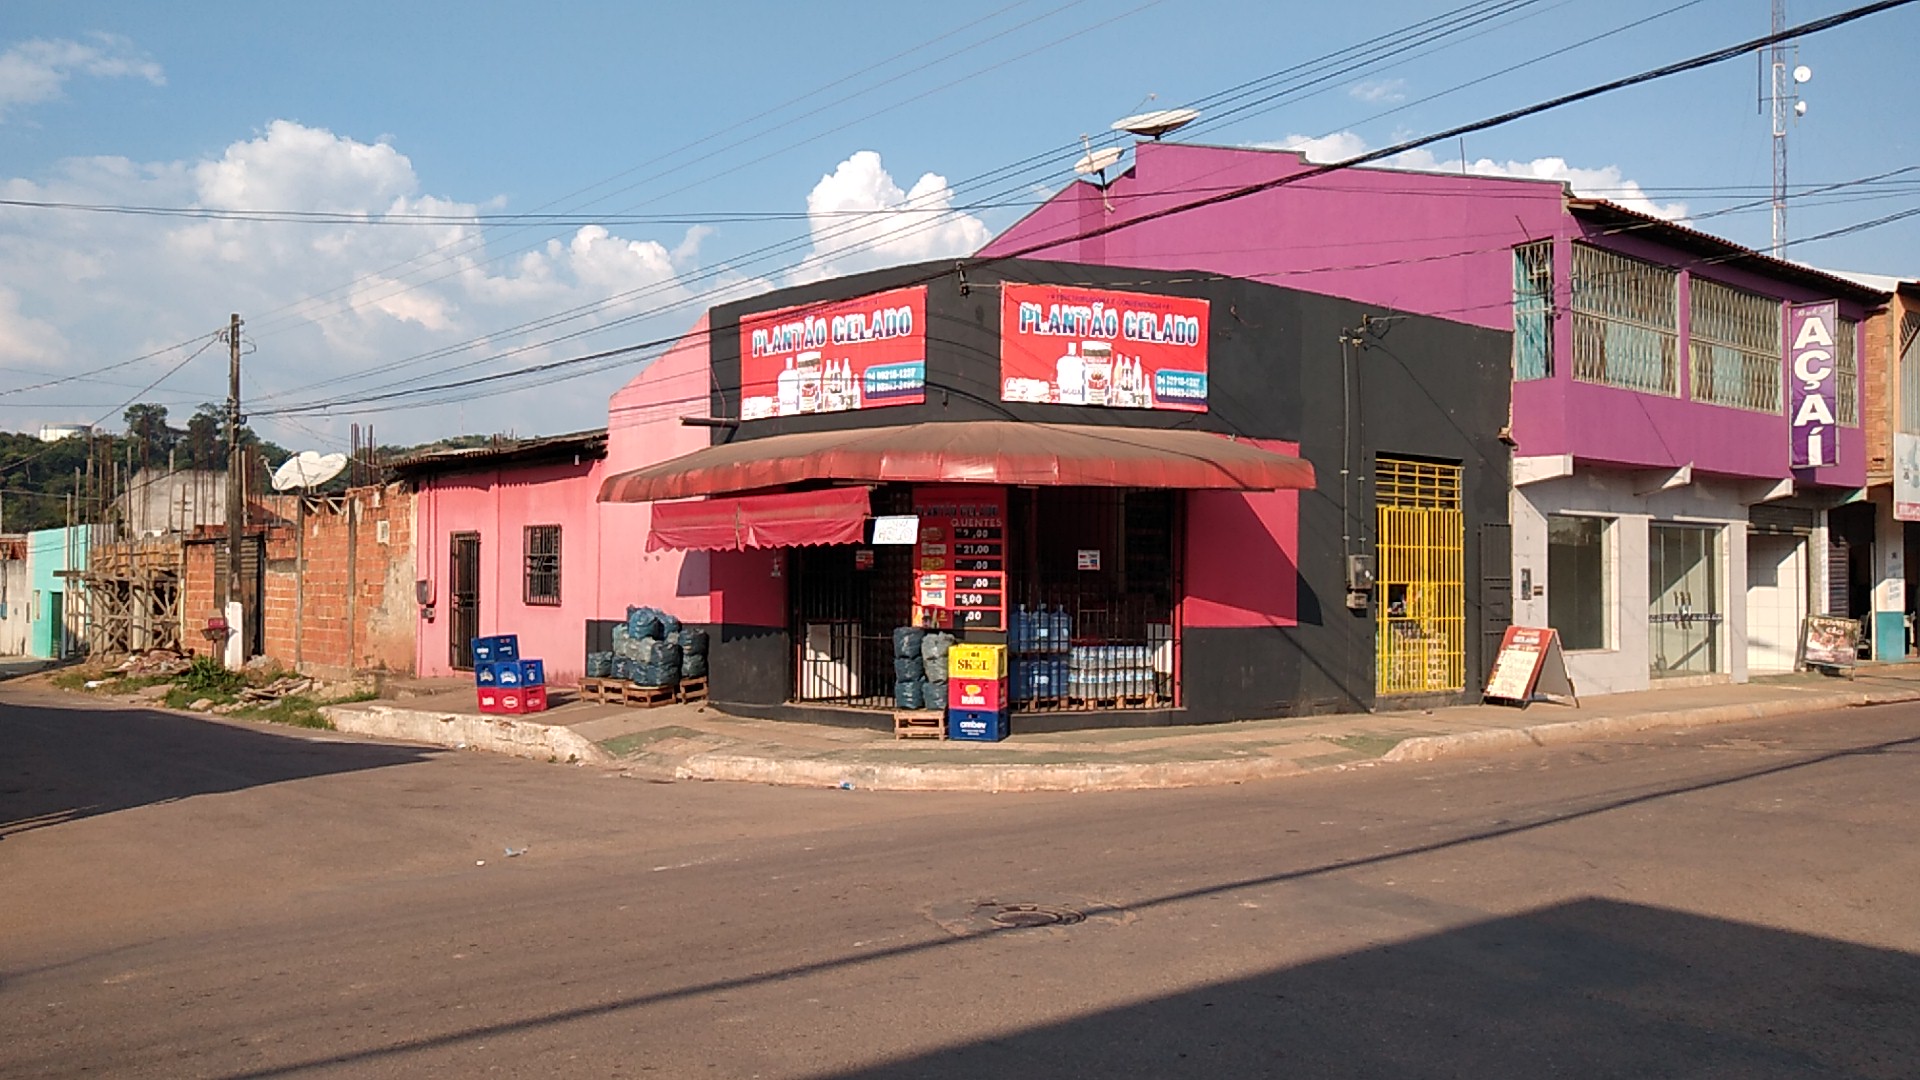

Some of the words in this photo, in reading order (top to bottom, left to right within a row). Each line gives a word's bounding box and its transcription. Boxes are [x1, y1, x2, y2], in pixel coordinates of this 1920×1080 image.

[752, 315, 827, 358] PLANTÃO
[832, 306, 912, 346] GELADO
[1019, 301, 1118, 339] PLANTÃO
[1123, 309, 1199, 346] GELADO
[1792, 317, 1835, 465] AÇAÍ
[951, 519, 1002, 528] QUENTES
[963, 545, 989, 554] 21,00
[962, 594, 982, 605] 5,00
